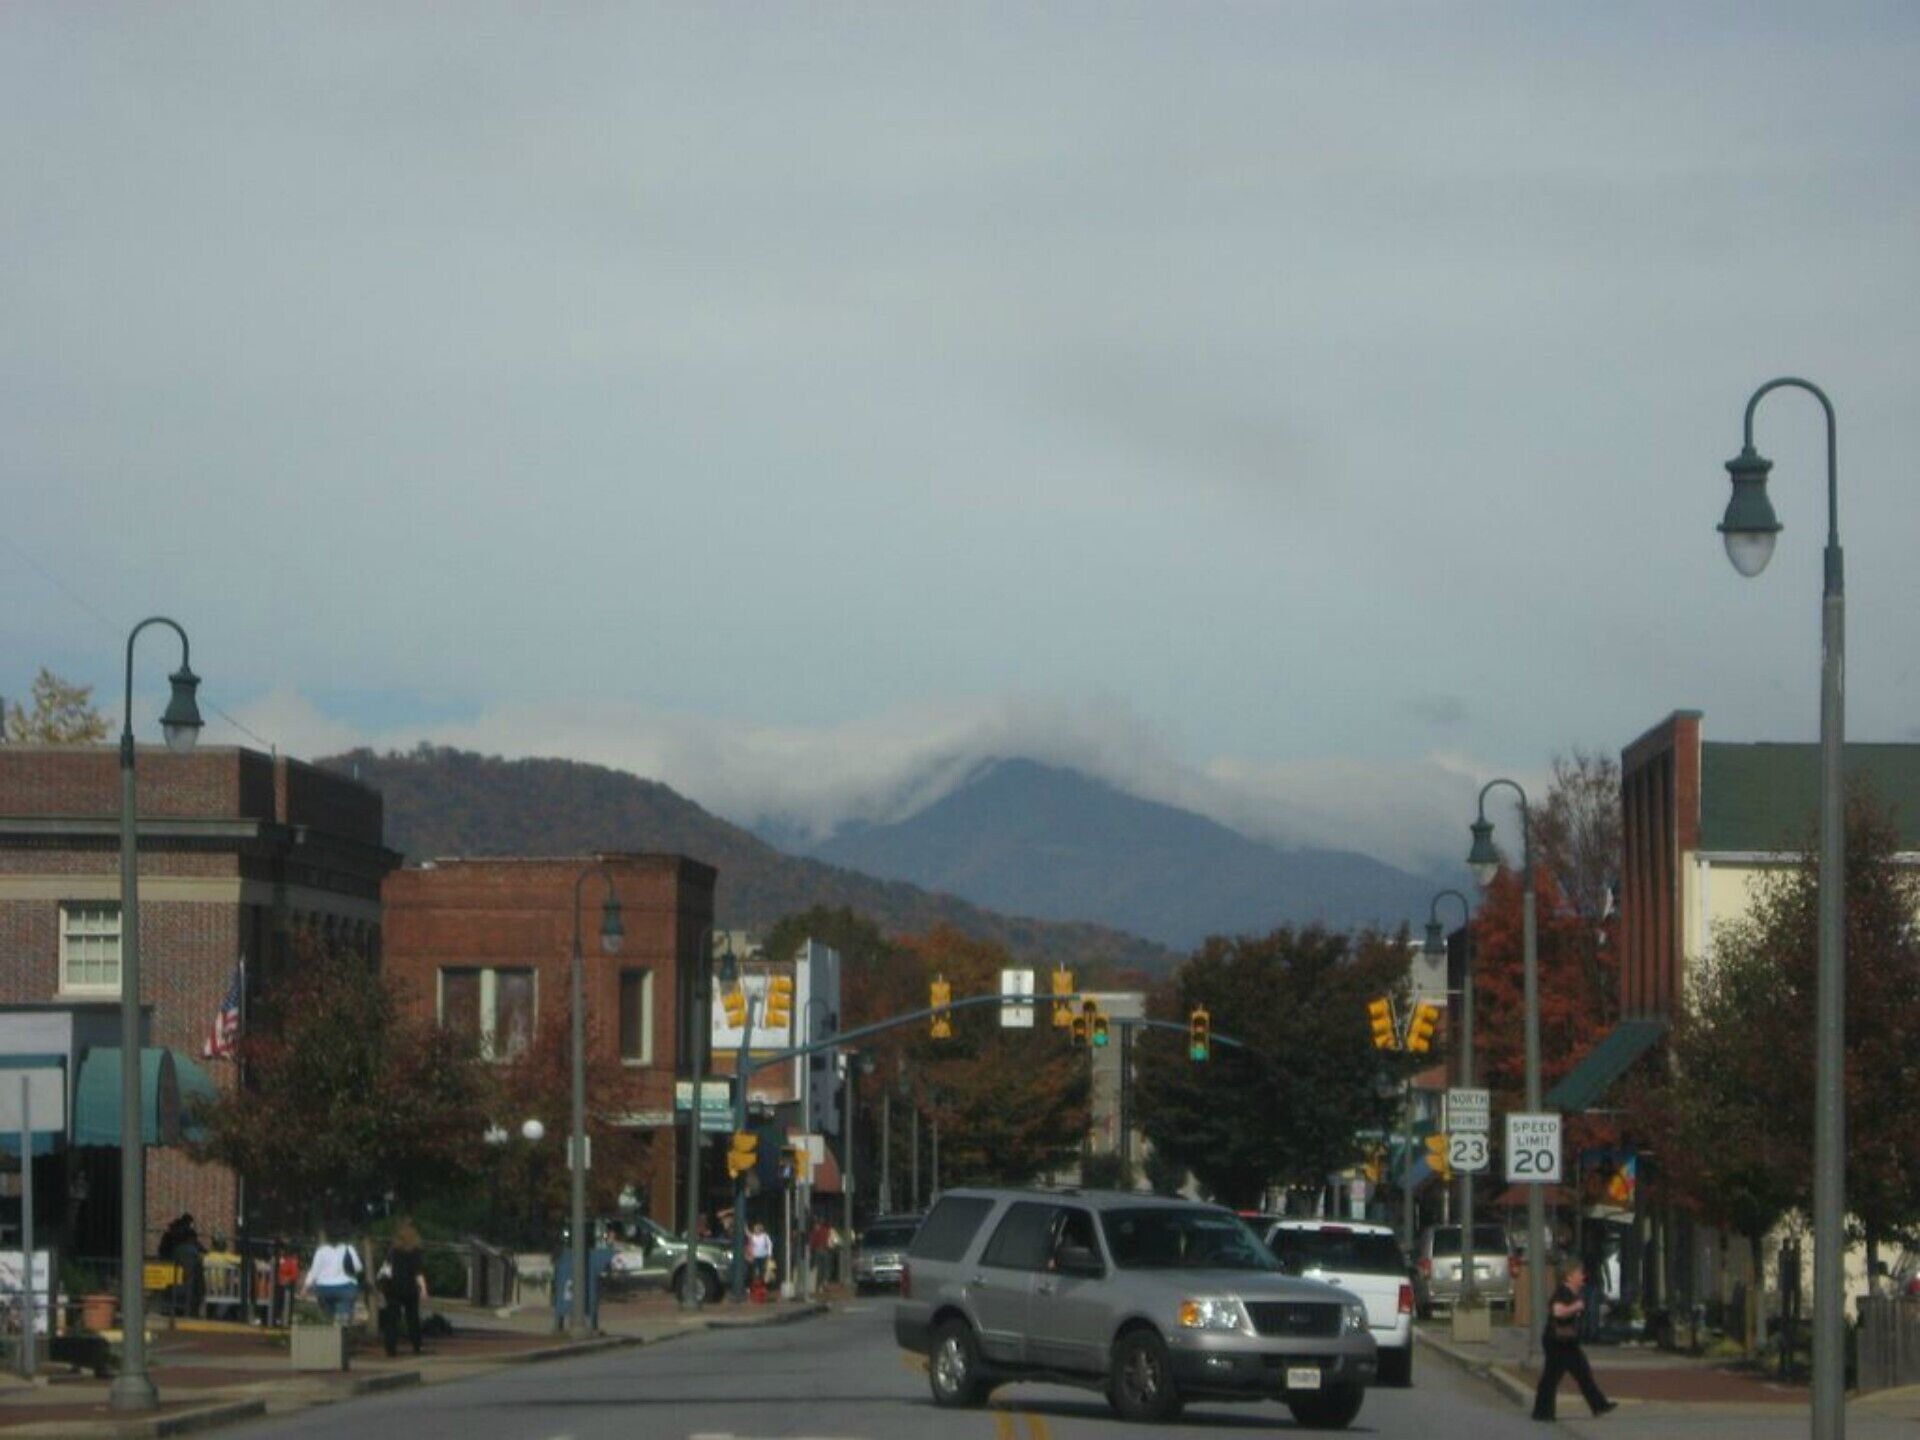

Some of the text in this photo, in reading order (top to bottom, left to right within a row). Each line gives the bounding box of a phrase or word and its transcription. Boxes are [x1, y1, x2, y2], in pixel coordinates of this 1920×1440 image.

[1450, 1094, 1489, 1105] NORTH
[1512, 1122, 1557, 1133] SPEED
[1517, 1136, 1551, 1145] LIMIT
[1452, 1140, 1485, 1163] 23
[1514, 1150, 1555, 1174] 20
